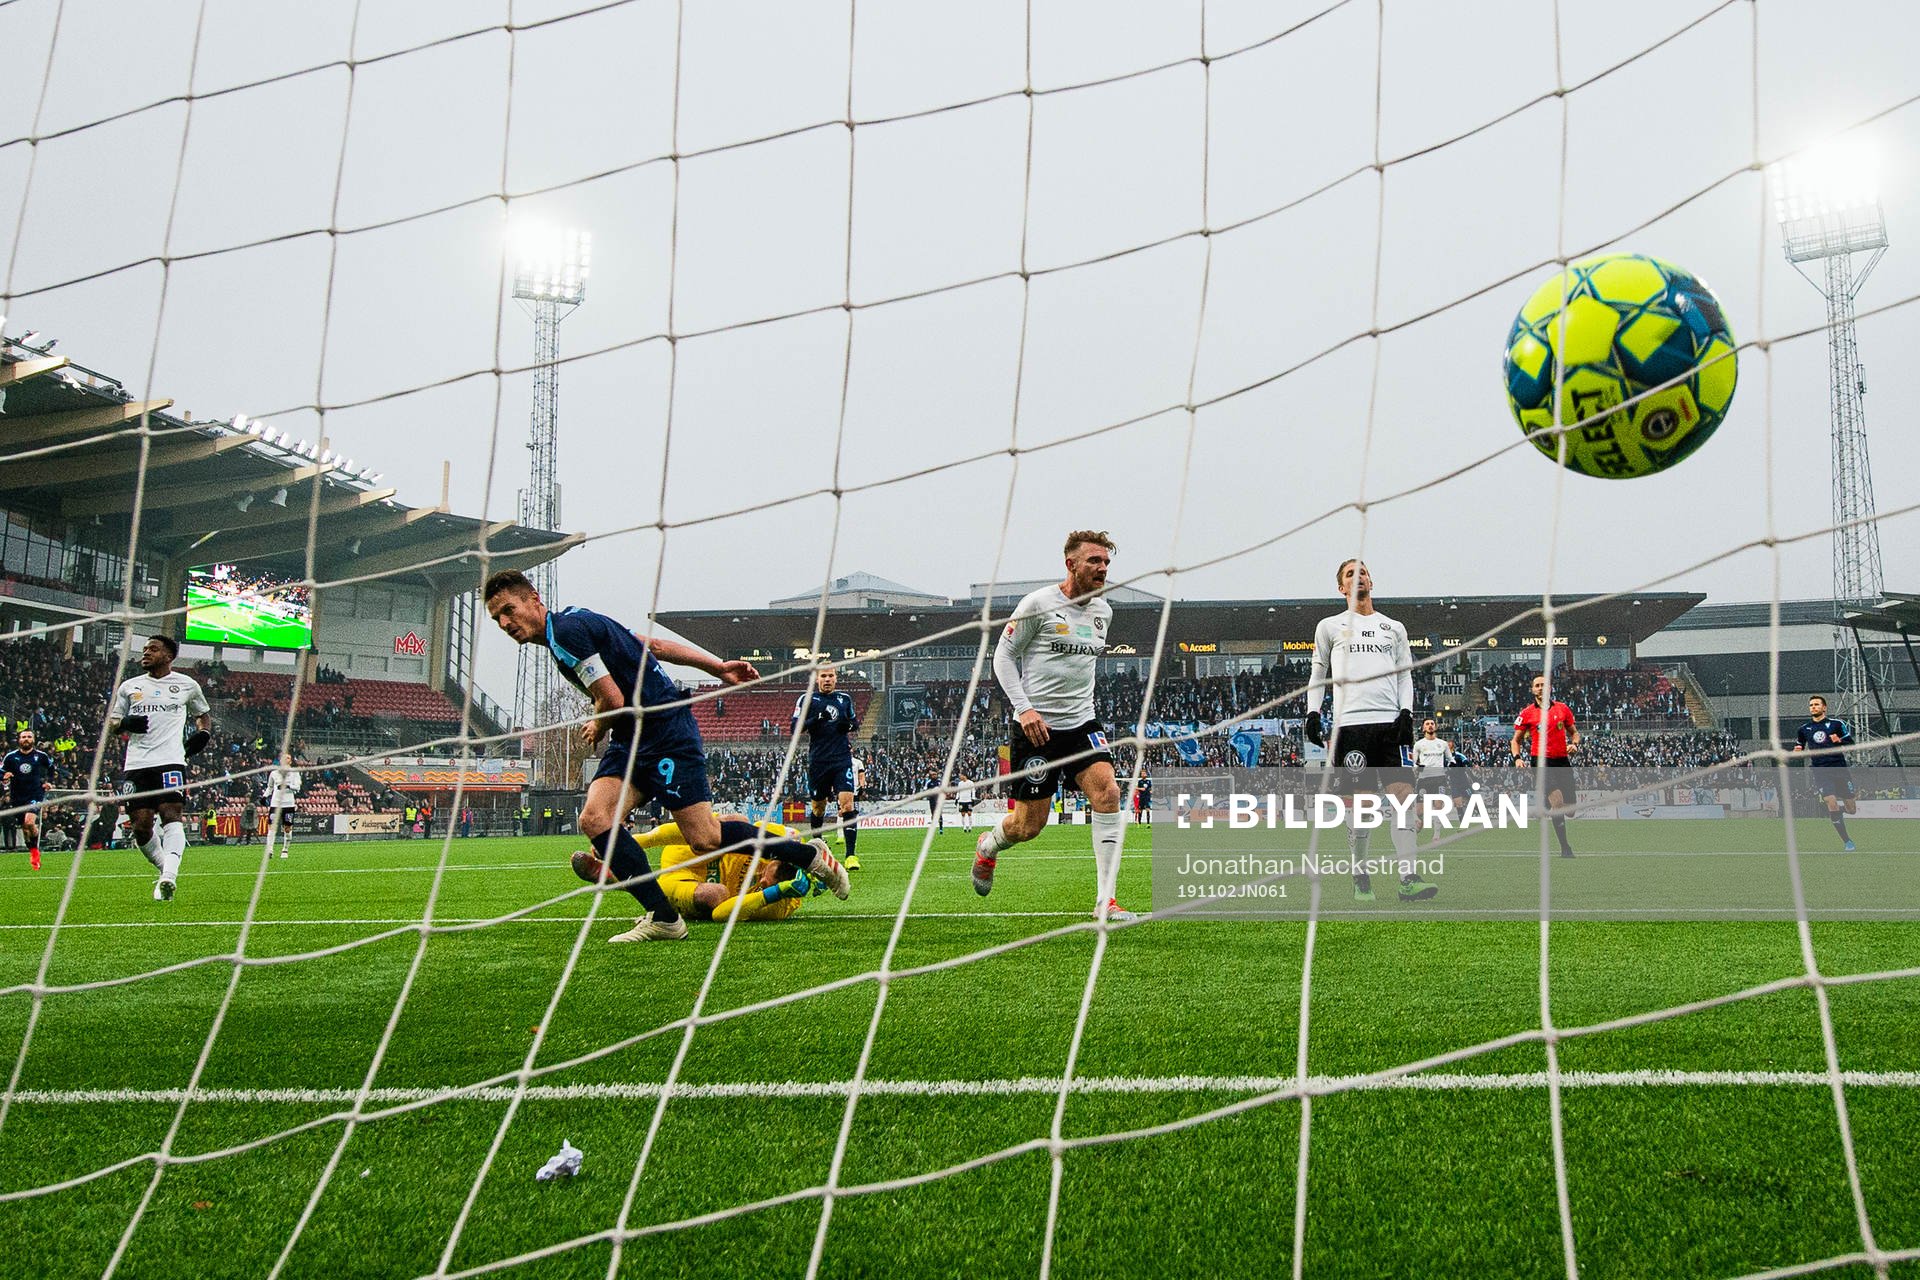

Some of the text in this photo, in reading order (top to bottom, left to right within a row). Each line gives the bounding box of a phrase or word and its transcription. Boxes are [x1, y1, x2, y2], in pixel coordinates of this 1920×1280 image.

[395, 631, 426, 655] MAX
[1283, 641, 1316, 650] Mobilve
[1521, 637, 1568, 646] MATCHOGE
[1051, 641, 1098, 655] BEHRN
[1346, 643, 1382, 653] EHRN
[657, 757, 675, 785] 9
[845, 767, 853, 779] 6
[1030, 786, 1039, 794] 14
